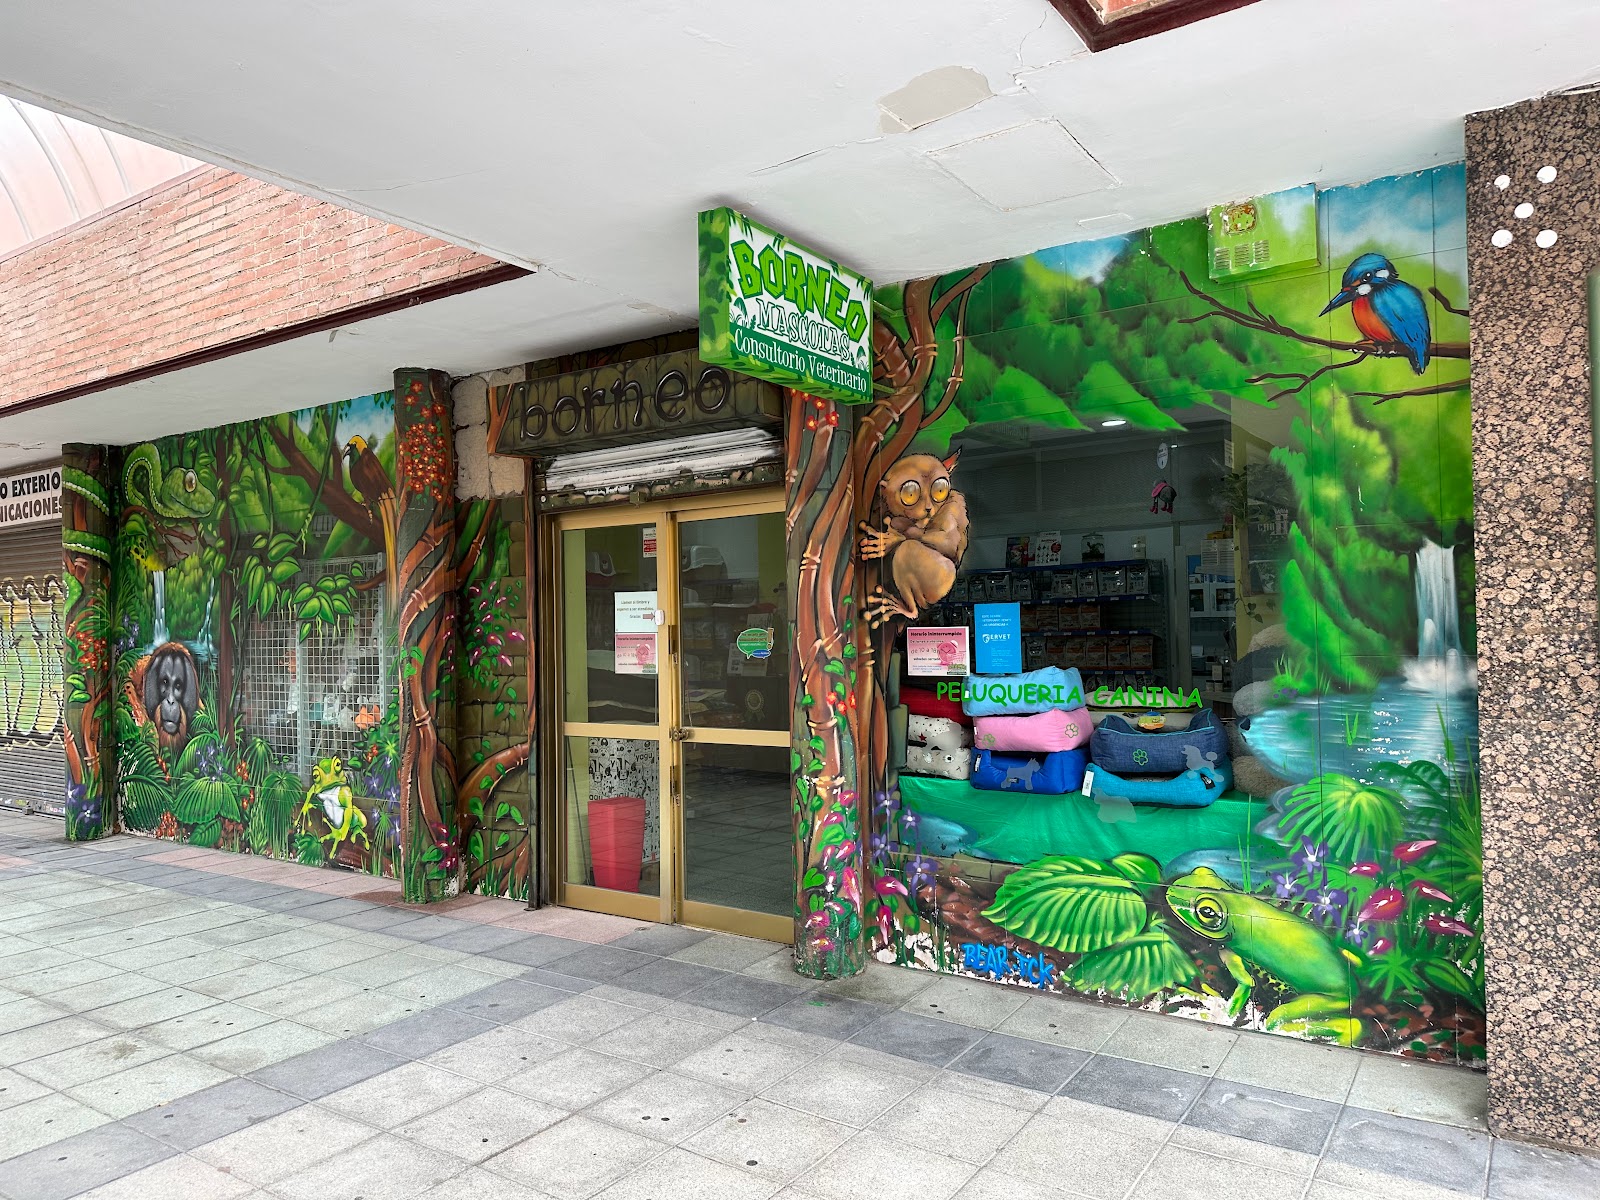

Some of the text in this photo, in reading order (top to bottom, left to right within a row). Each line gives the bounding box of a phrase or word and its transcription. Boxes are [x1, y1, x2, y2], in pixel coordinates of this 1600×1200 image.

[731, 239, 868, 343] BORNEO
[734, 328, 867, 393] Consultorio Veterinario
[756, 298, 850, 361] MASCOTAS
[520, 366, 731, 442] borneo
[12, 471, 61, 498] EXTERIO
[937, 681, 1203, 708] PELUQUERIA CANINA
[961, 942, 1012, 980] BEAR
